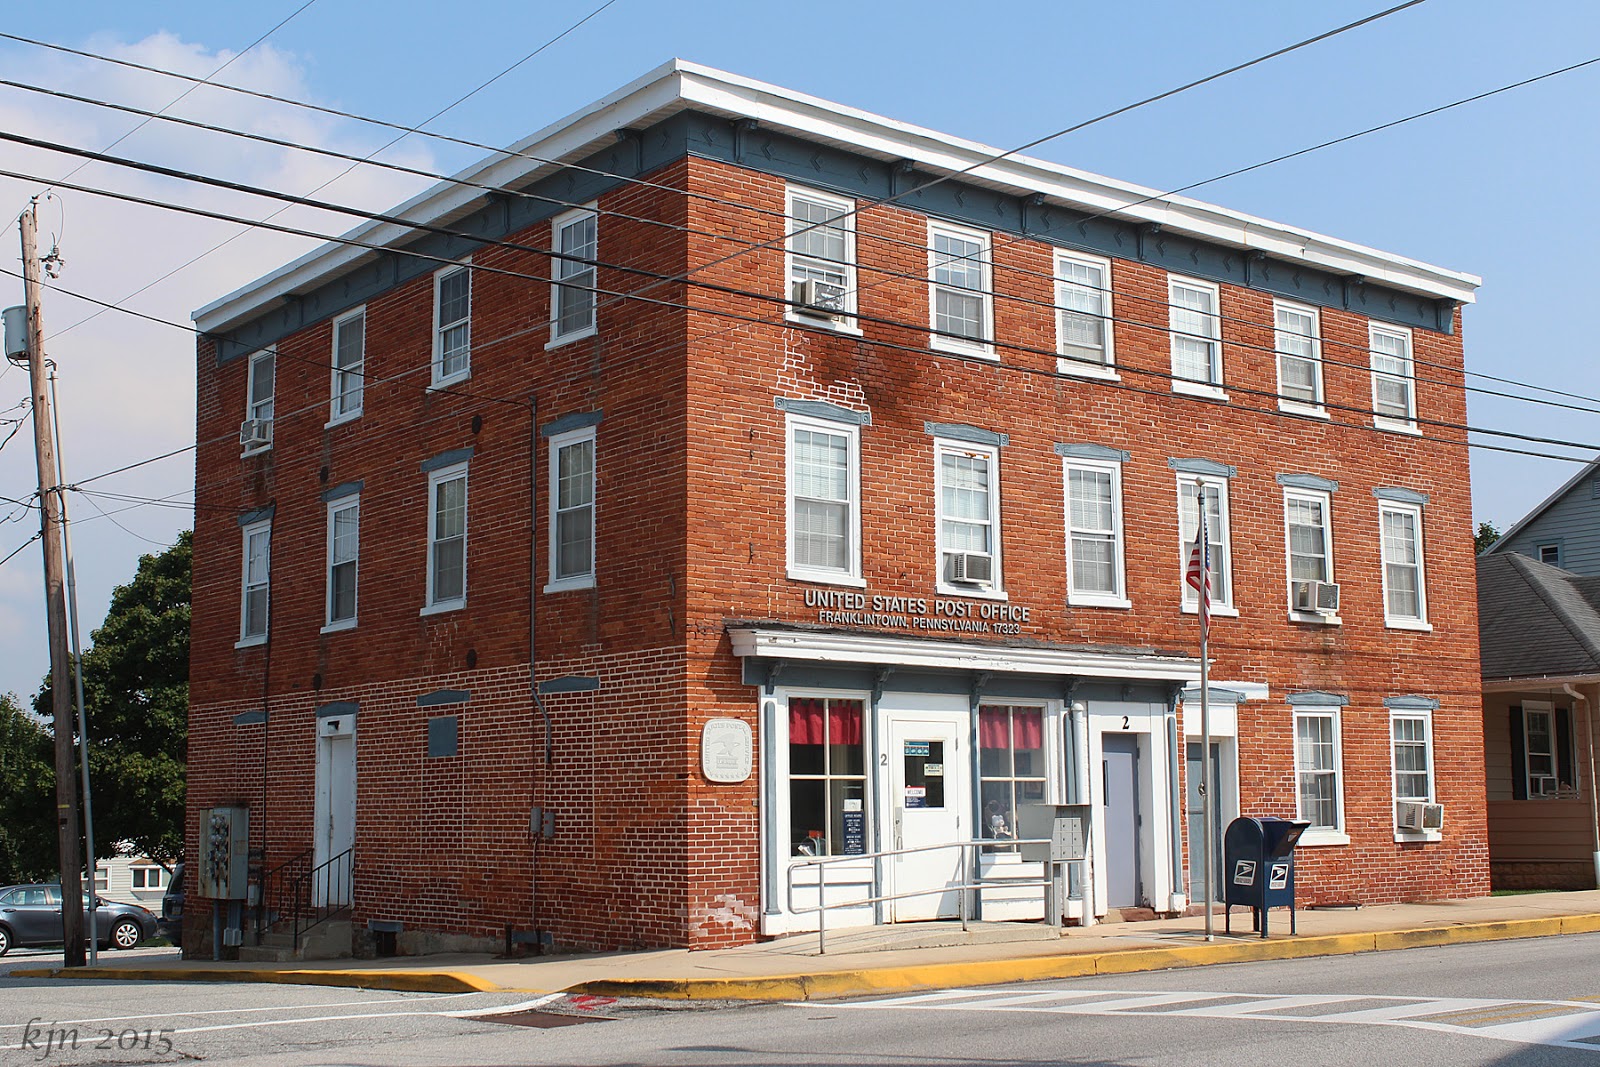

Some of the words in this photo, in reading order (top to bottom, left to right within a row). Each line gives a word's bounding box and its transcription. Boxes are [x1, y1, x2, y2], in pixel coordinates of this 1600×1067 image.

[805, 589, 866, 609] UNITED
[873, 595, 927, 614] STATES
[935, 599, 974, 618] POST
[980, 603, 1031, 622] OFFICE
[819, 610, 909, 629] FRANKLINTOWN,
[913, 617, 989, 633] PENNSYLVANIA
[992, 622, 1021, 634] 17323
[1121, 715, 1130, 730] 2
[880, 753, 888, 766] 2
